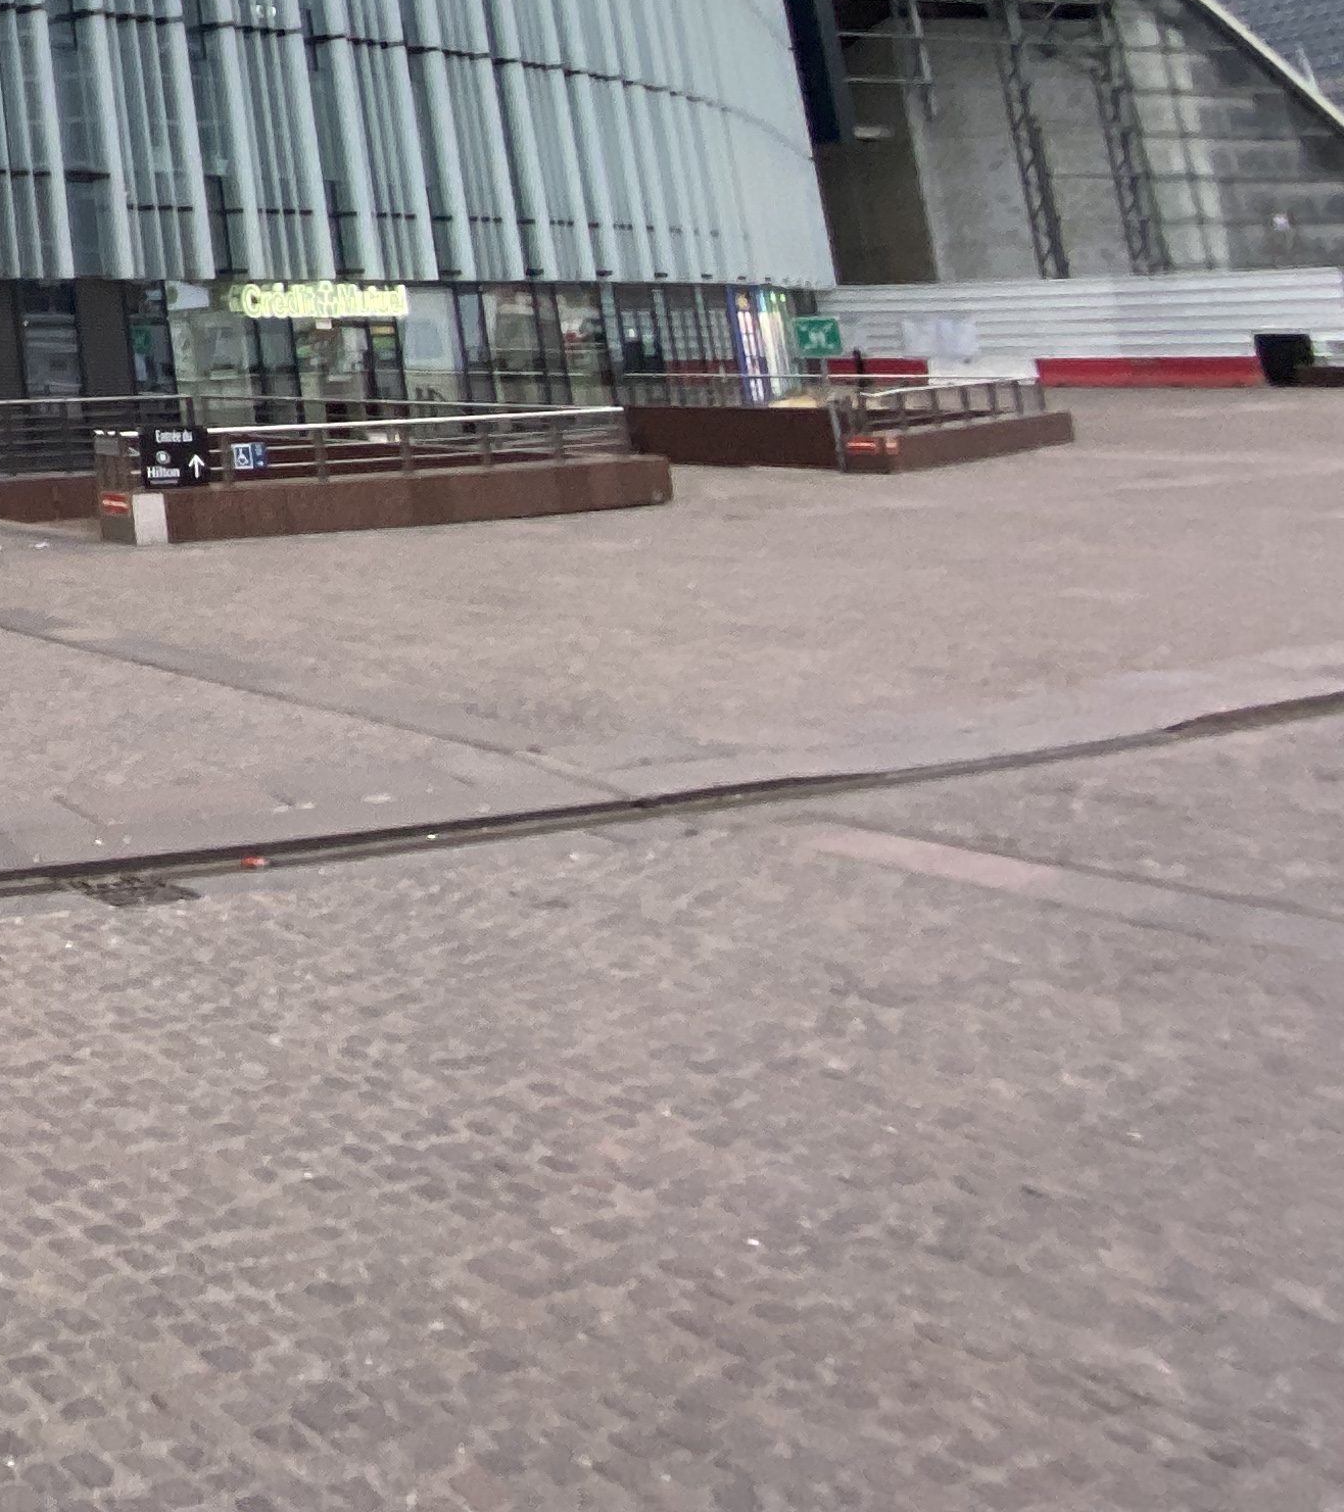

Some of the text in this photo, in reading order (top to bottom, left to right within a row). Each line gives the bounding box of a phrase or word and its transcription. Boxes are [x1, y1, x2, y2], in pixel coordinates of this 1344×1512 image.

[241, 282, 316, 319] Crédit
[155, 429, 181, 444] Entrée
[147, 466, 180, 479] Hilton
